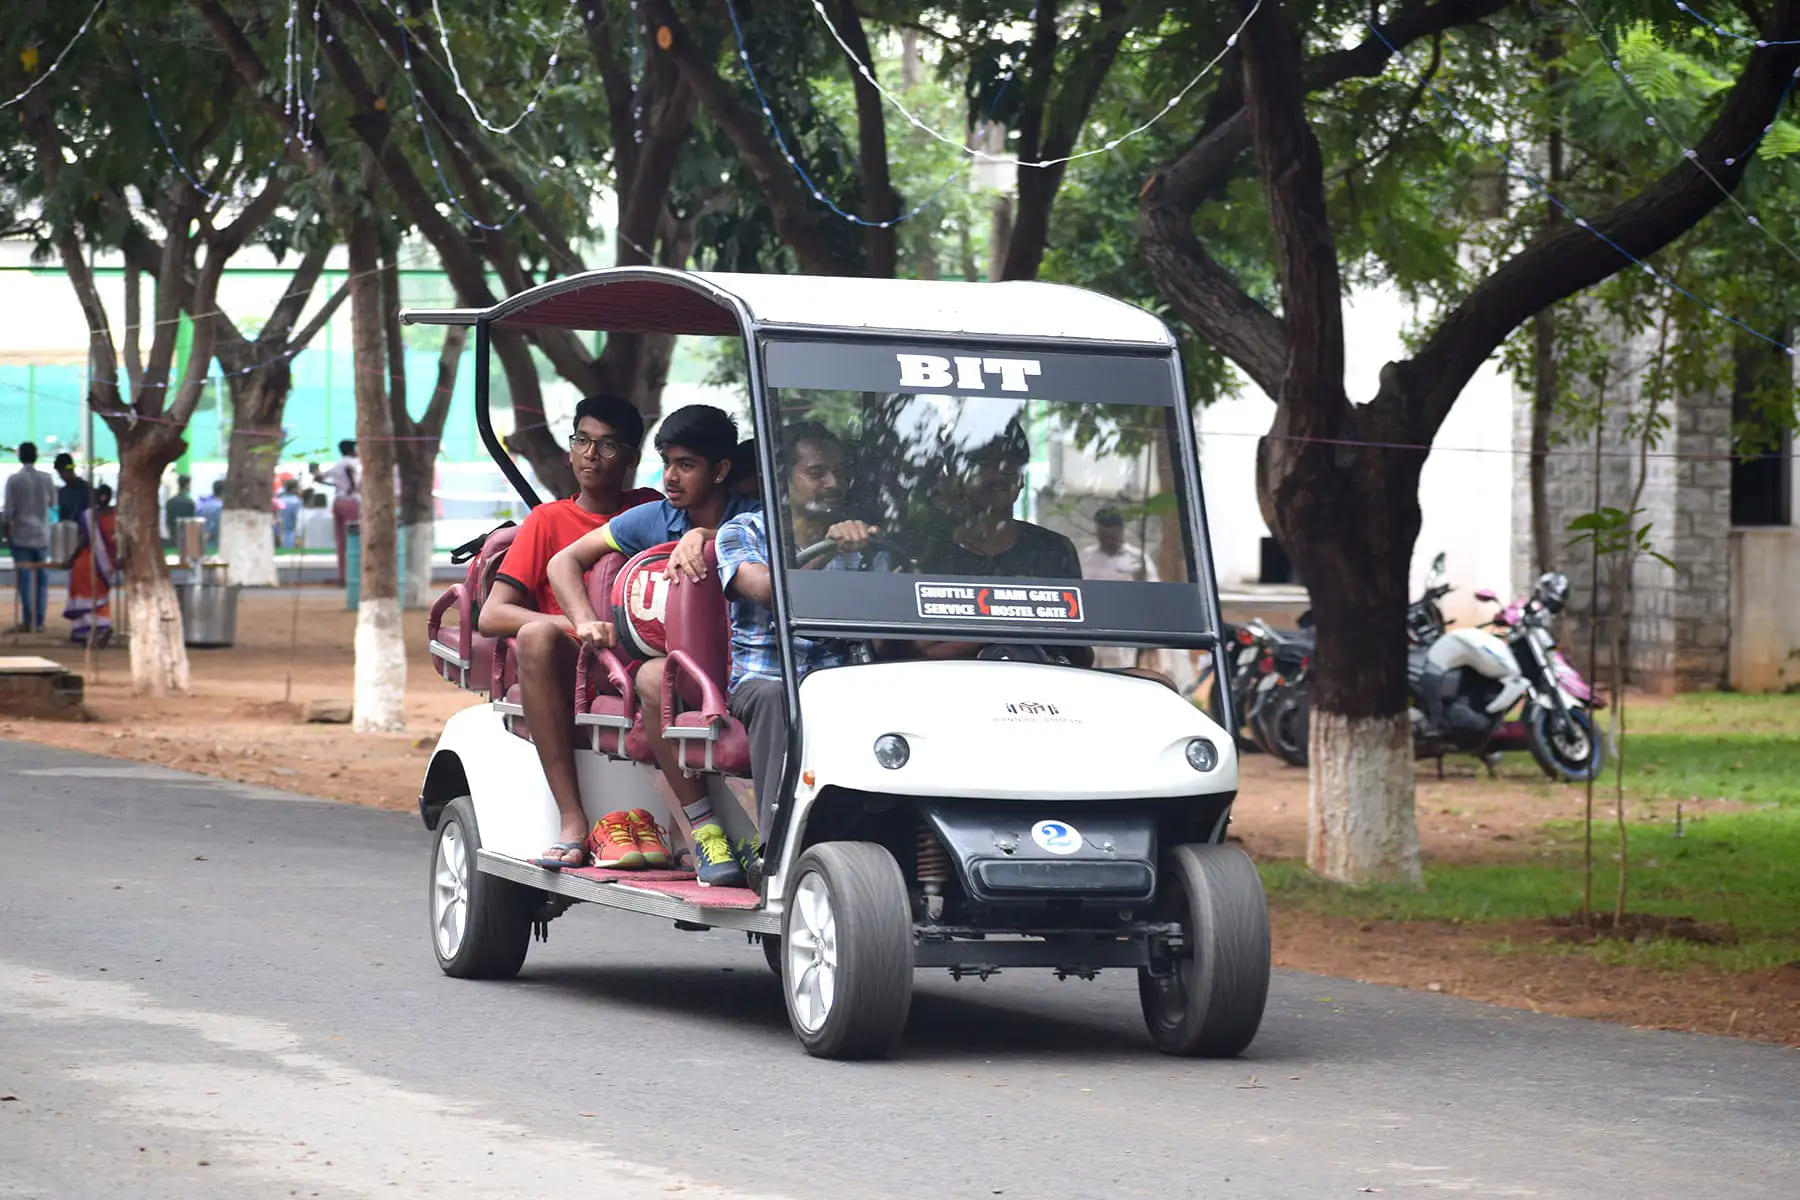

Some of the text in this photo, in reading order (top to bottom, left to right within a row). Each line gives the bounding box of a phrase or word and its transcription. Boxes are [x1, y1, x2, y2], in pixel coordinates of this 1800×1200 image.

[896, 353, 1042, 392] BIT
[919, 586, 976, 600] SHUTTLE
[993, 588, 1060, 603] MAIN GATE
[923, 602, 976, 616] SERVICE
[989, 605, 1068, 619] HOSTEL GATE
[1041, 824, 1073, 847] 2
